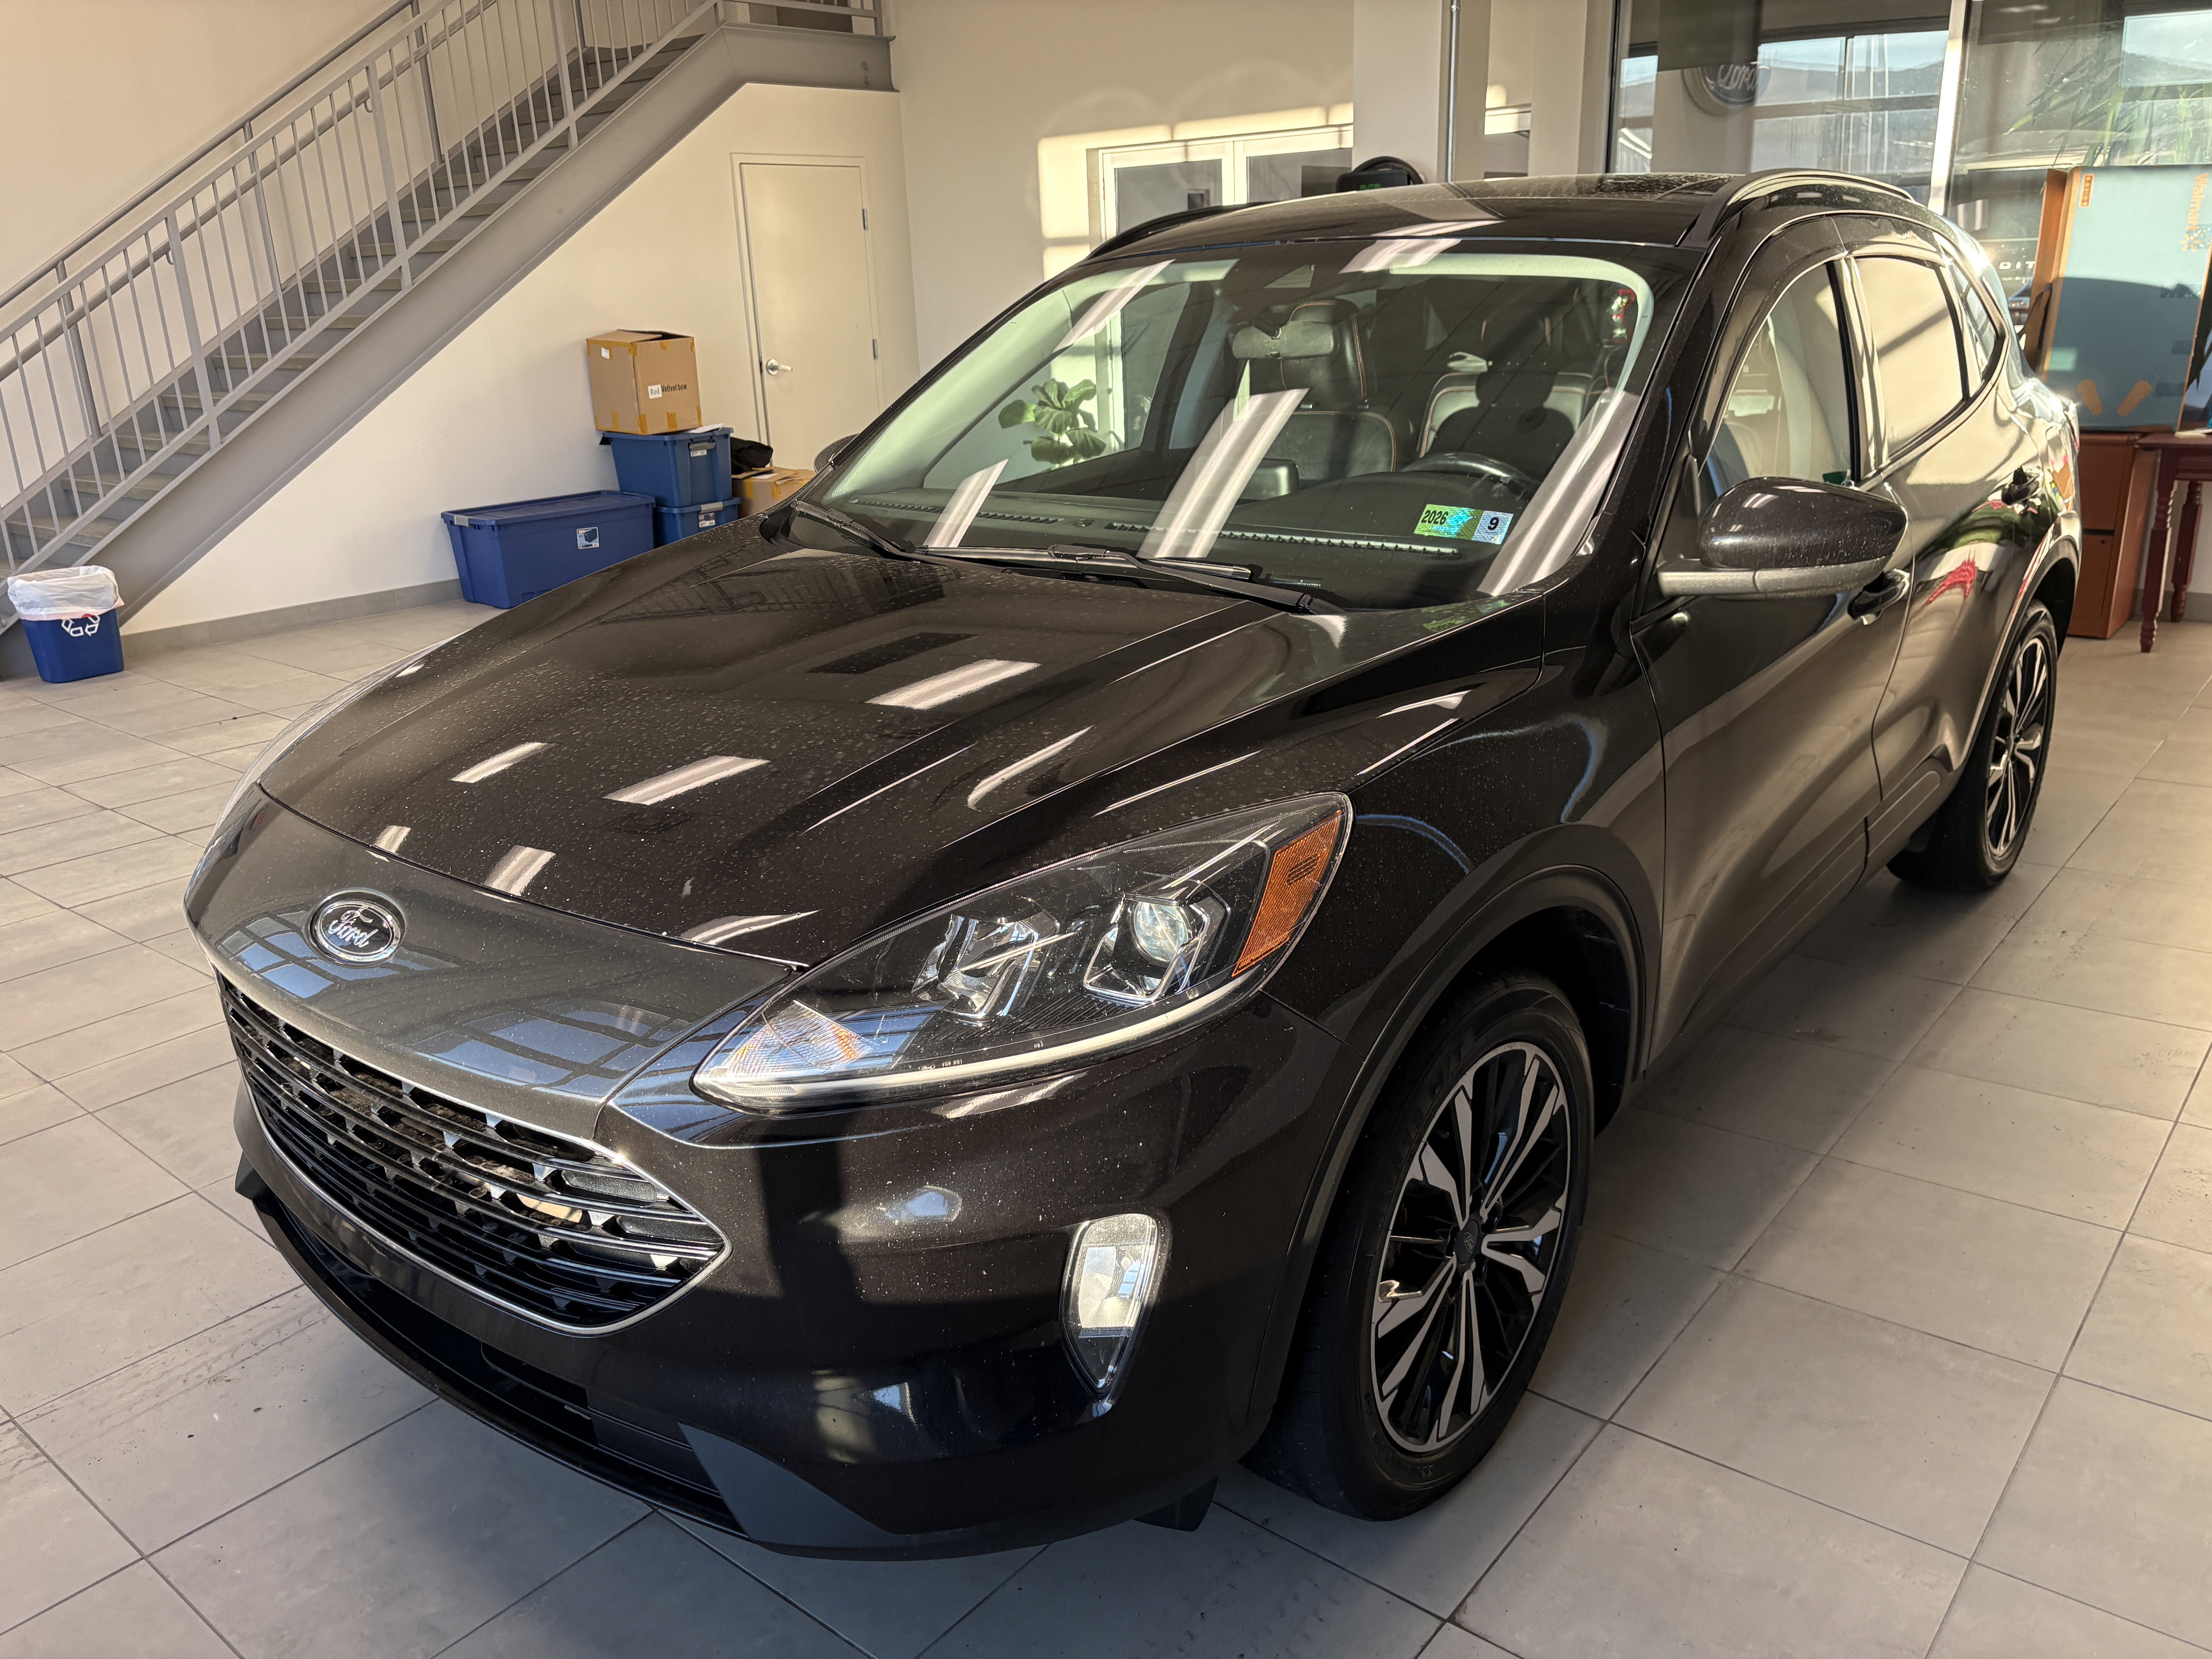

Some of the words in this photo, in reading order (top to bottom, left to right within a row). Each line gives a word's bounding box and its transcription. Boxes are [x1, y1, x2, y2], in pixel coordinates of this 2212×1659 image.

[2186, 173, 2210, 232] Walmart
[1421, 510, 1448, 525] 2026
[1487, 517, 1499, 531] 9
[328, 908, 379, 948] Ford
